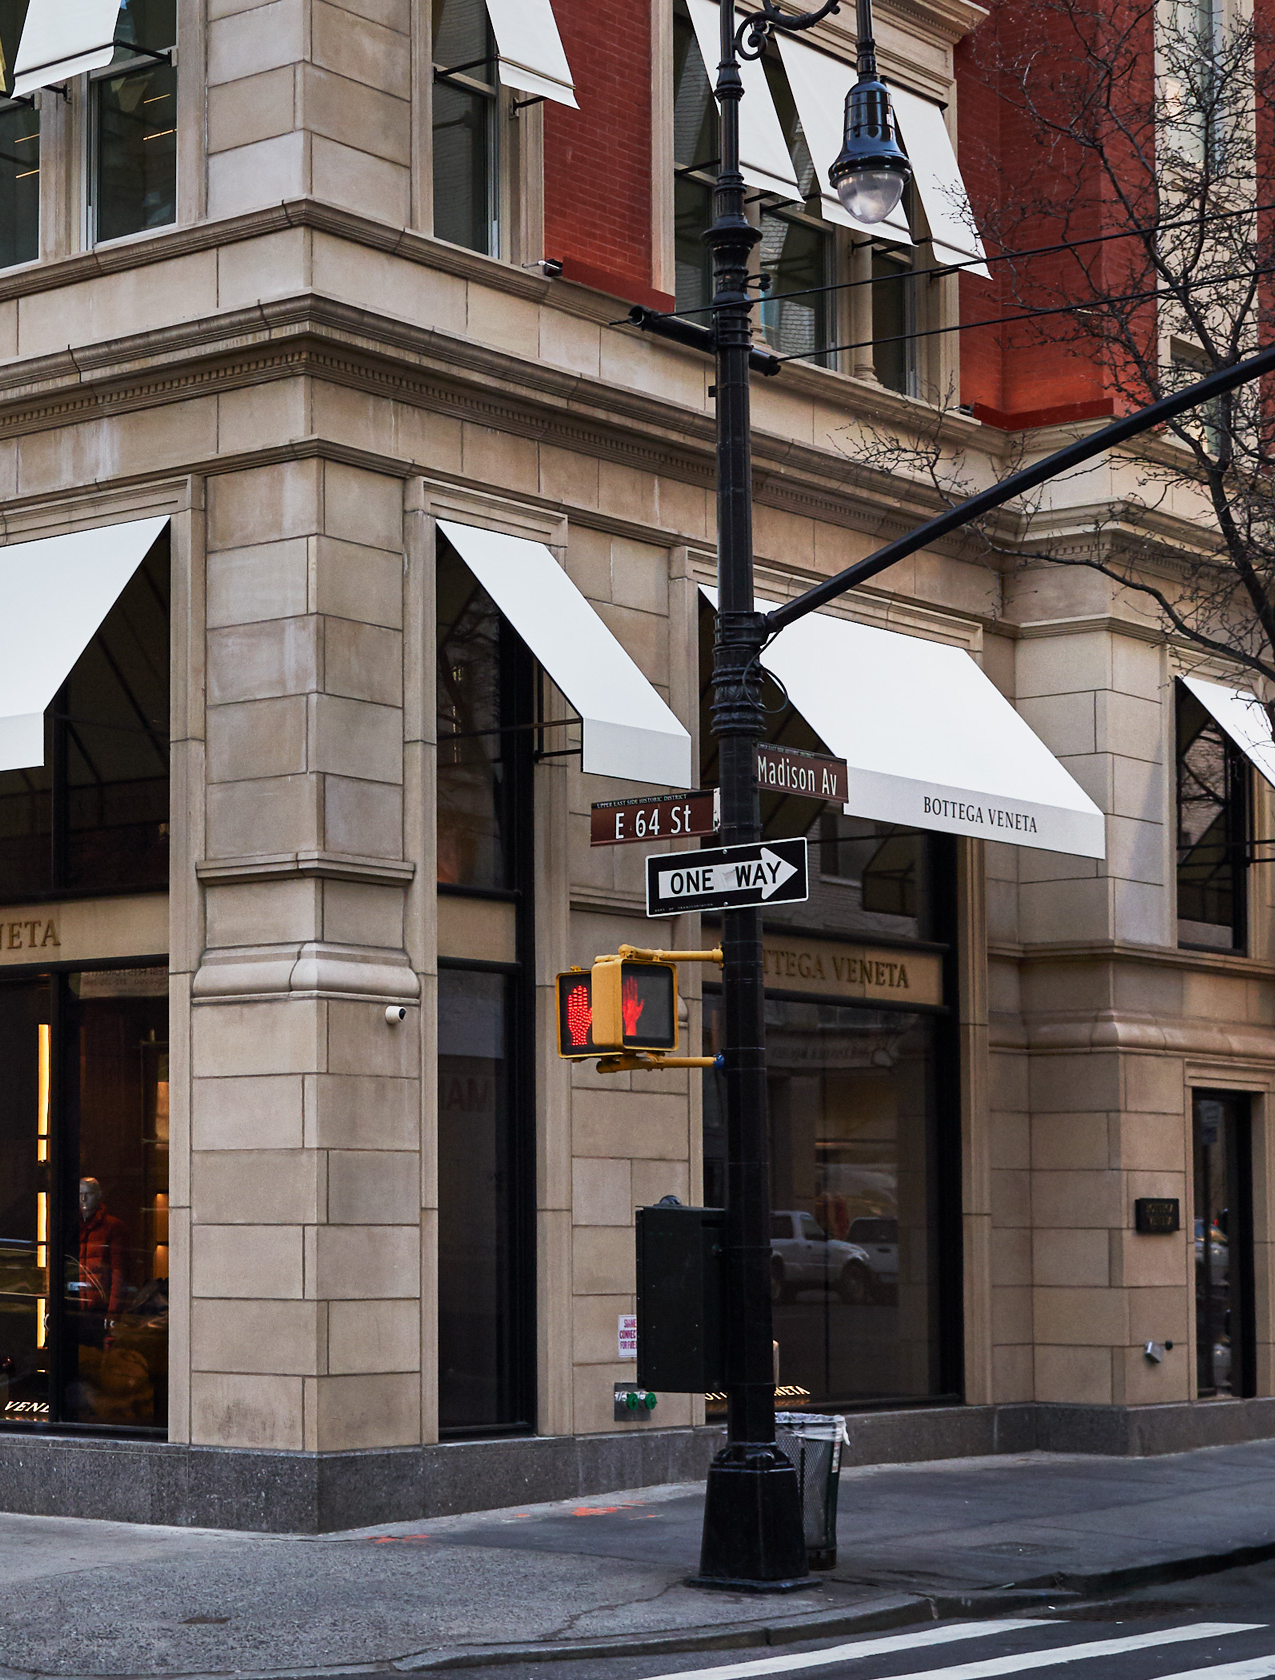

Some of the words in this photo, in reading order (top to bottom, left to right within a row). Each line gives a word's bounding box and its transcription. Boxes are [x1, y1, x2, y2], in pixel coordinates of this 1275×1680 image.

[757, 755, 815, 792] Madison
[821, 767, 837, 796] Av
[615, 812, 625, 840] E
[635, 808, 660, 838] 64
[670, 804, 692, 834] St
[923, 796, 984, 824] BOTTEGA
[988, 808, 1037, 833] VENETA
[670, 868, 714, 895] ONE
[735, 861, 782, 888] WAY
[762, 949, 826, 981] TTEGA
[832, 956, 910, 989] VENETA
[619, 1330, 637, 1339] CONNEC
[773, 1385, 811, 1397] NETA
